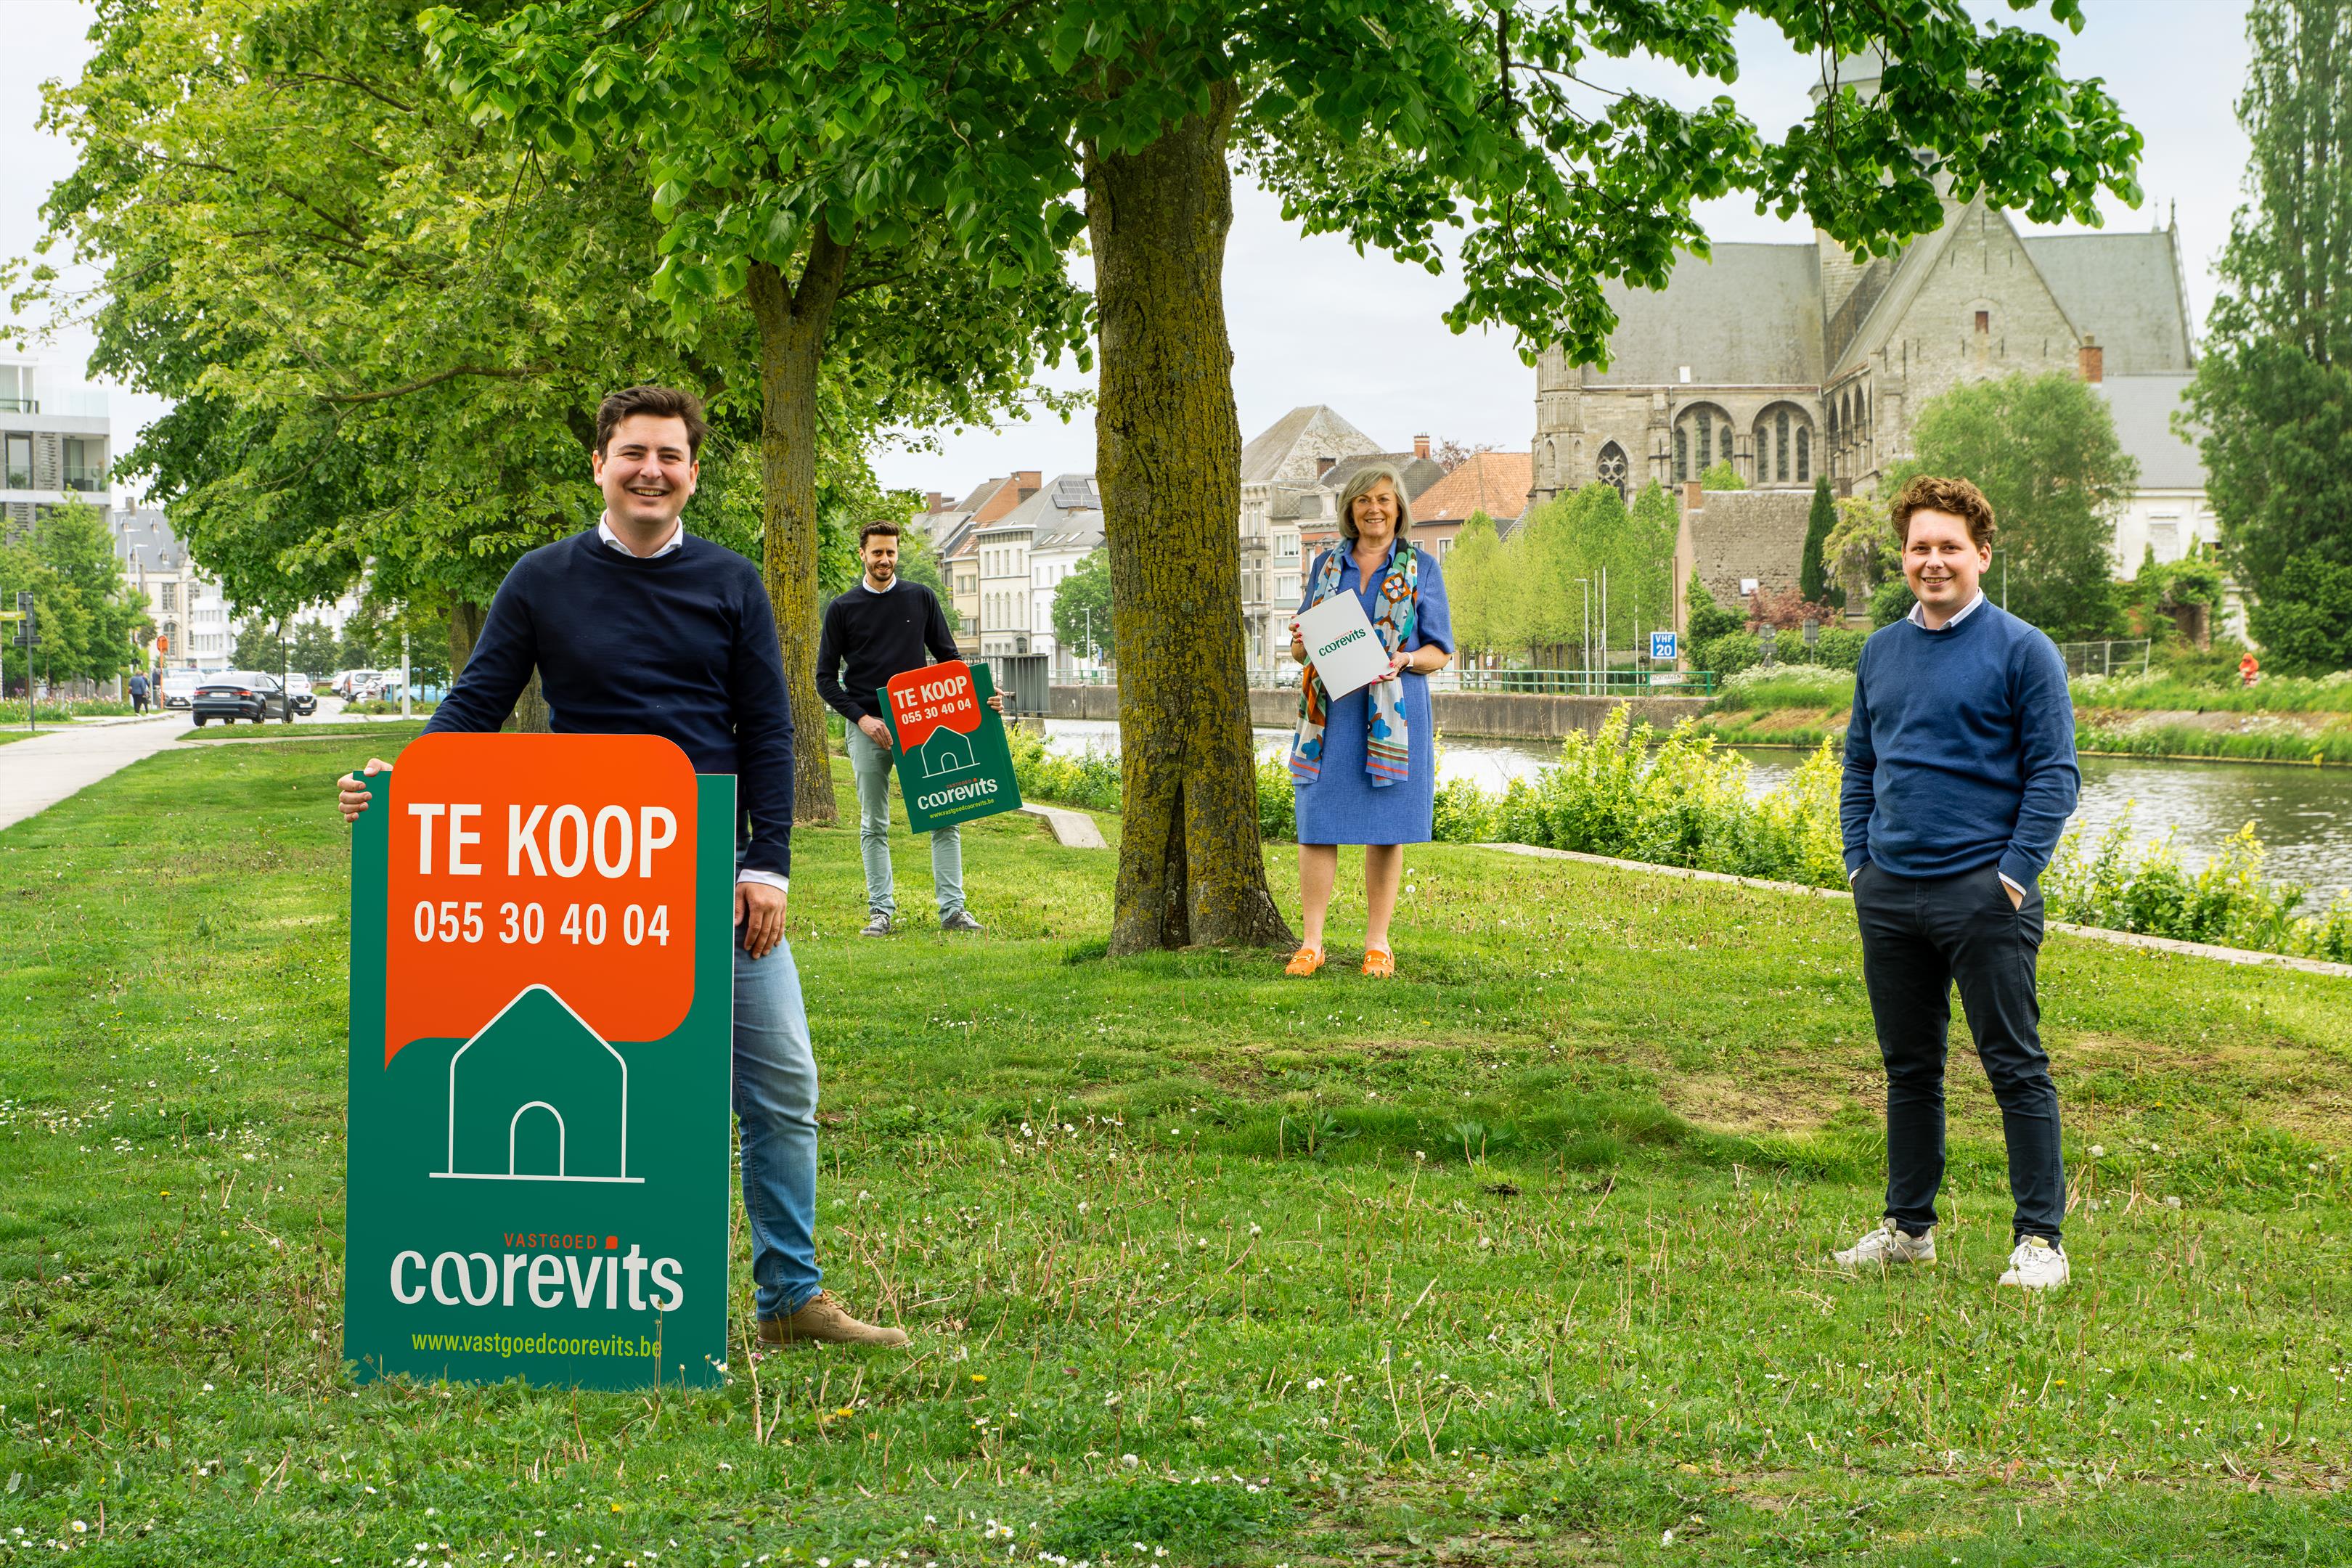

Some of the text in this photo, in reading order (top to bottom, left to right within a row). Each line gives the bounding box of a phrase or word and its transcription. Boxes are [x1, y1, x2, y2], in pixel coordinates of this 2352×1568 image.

[1318, 629, 1366, 656] coorevits
[1655, 634, 1673, 643] VHF
[1656, 645, 1672, 656] 20
[893, 675, 968, 709] TE KOOP
[902, 698, 971, 725] 055 30 40 04
[917, 777, 998, 810] coorevits
[929, 798, 995, 820] www.vastgoedcoorevits.be
[408, 803, 677, 878] TE KOOP
[414, 900, 670, 947] 055 30 40 04
[504, 1233, 597, 1249] VASTGOED
[390, 1236, 684, 1312] coorevits
[412, 1332, 662, 1358] www.vastgoedcoorevits.be
